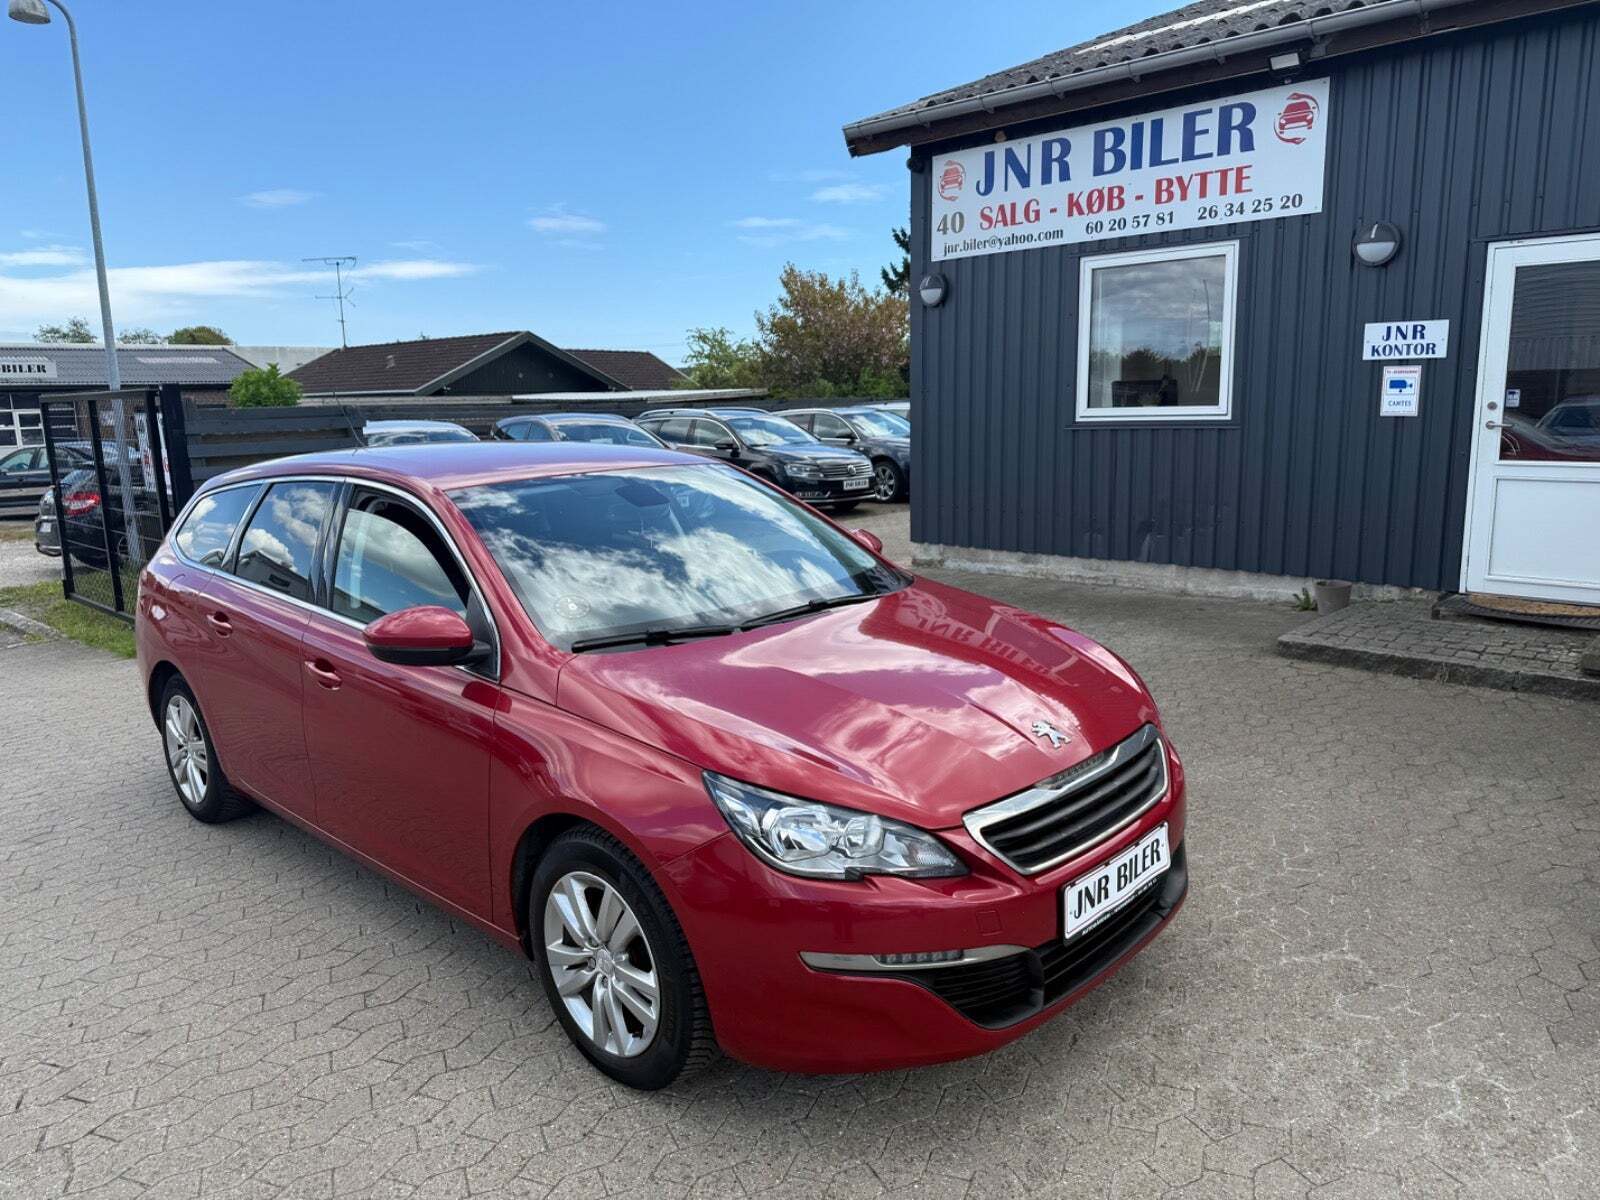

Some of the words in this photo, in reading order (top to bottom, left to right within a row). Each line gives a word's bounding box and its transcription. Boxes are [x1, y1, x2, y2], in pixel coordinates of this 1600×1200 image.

[976, 138, 1071, 196] JNR
[1093, 102, 1256, 176] BILER
[980, 199, 1040, 230] SALG
[1067, 186, 1125, 217] KØB
[1155, 165, 1253, 204] BYTTE
[1198, 205, 1218, 220] 26
[1225, 202, 1244, 216] 34
[1252, 198, 1273, 213] 25
[1280, 194, 1303, 209] 20
[937, 211, 965, 235] 40
[1086, 221, 1103, 234] 60
[1109, 217, 1126, 231] 20
[1132, 214, 1150, 228] 57
[1156, 211, 1173, 225] 81
[944, 229, 1064, 256] jnr.biler@yahoo.com
[1382, 324, 1426, 341] JNR
[1371, 342, 1436, 357] KONTOR
[1, 363, 47, 373] BILER
[1074, 874, 1109, 919] JNR
[1117, 838, 1161, 892] BILER
